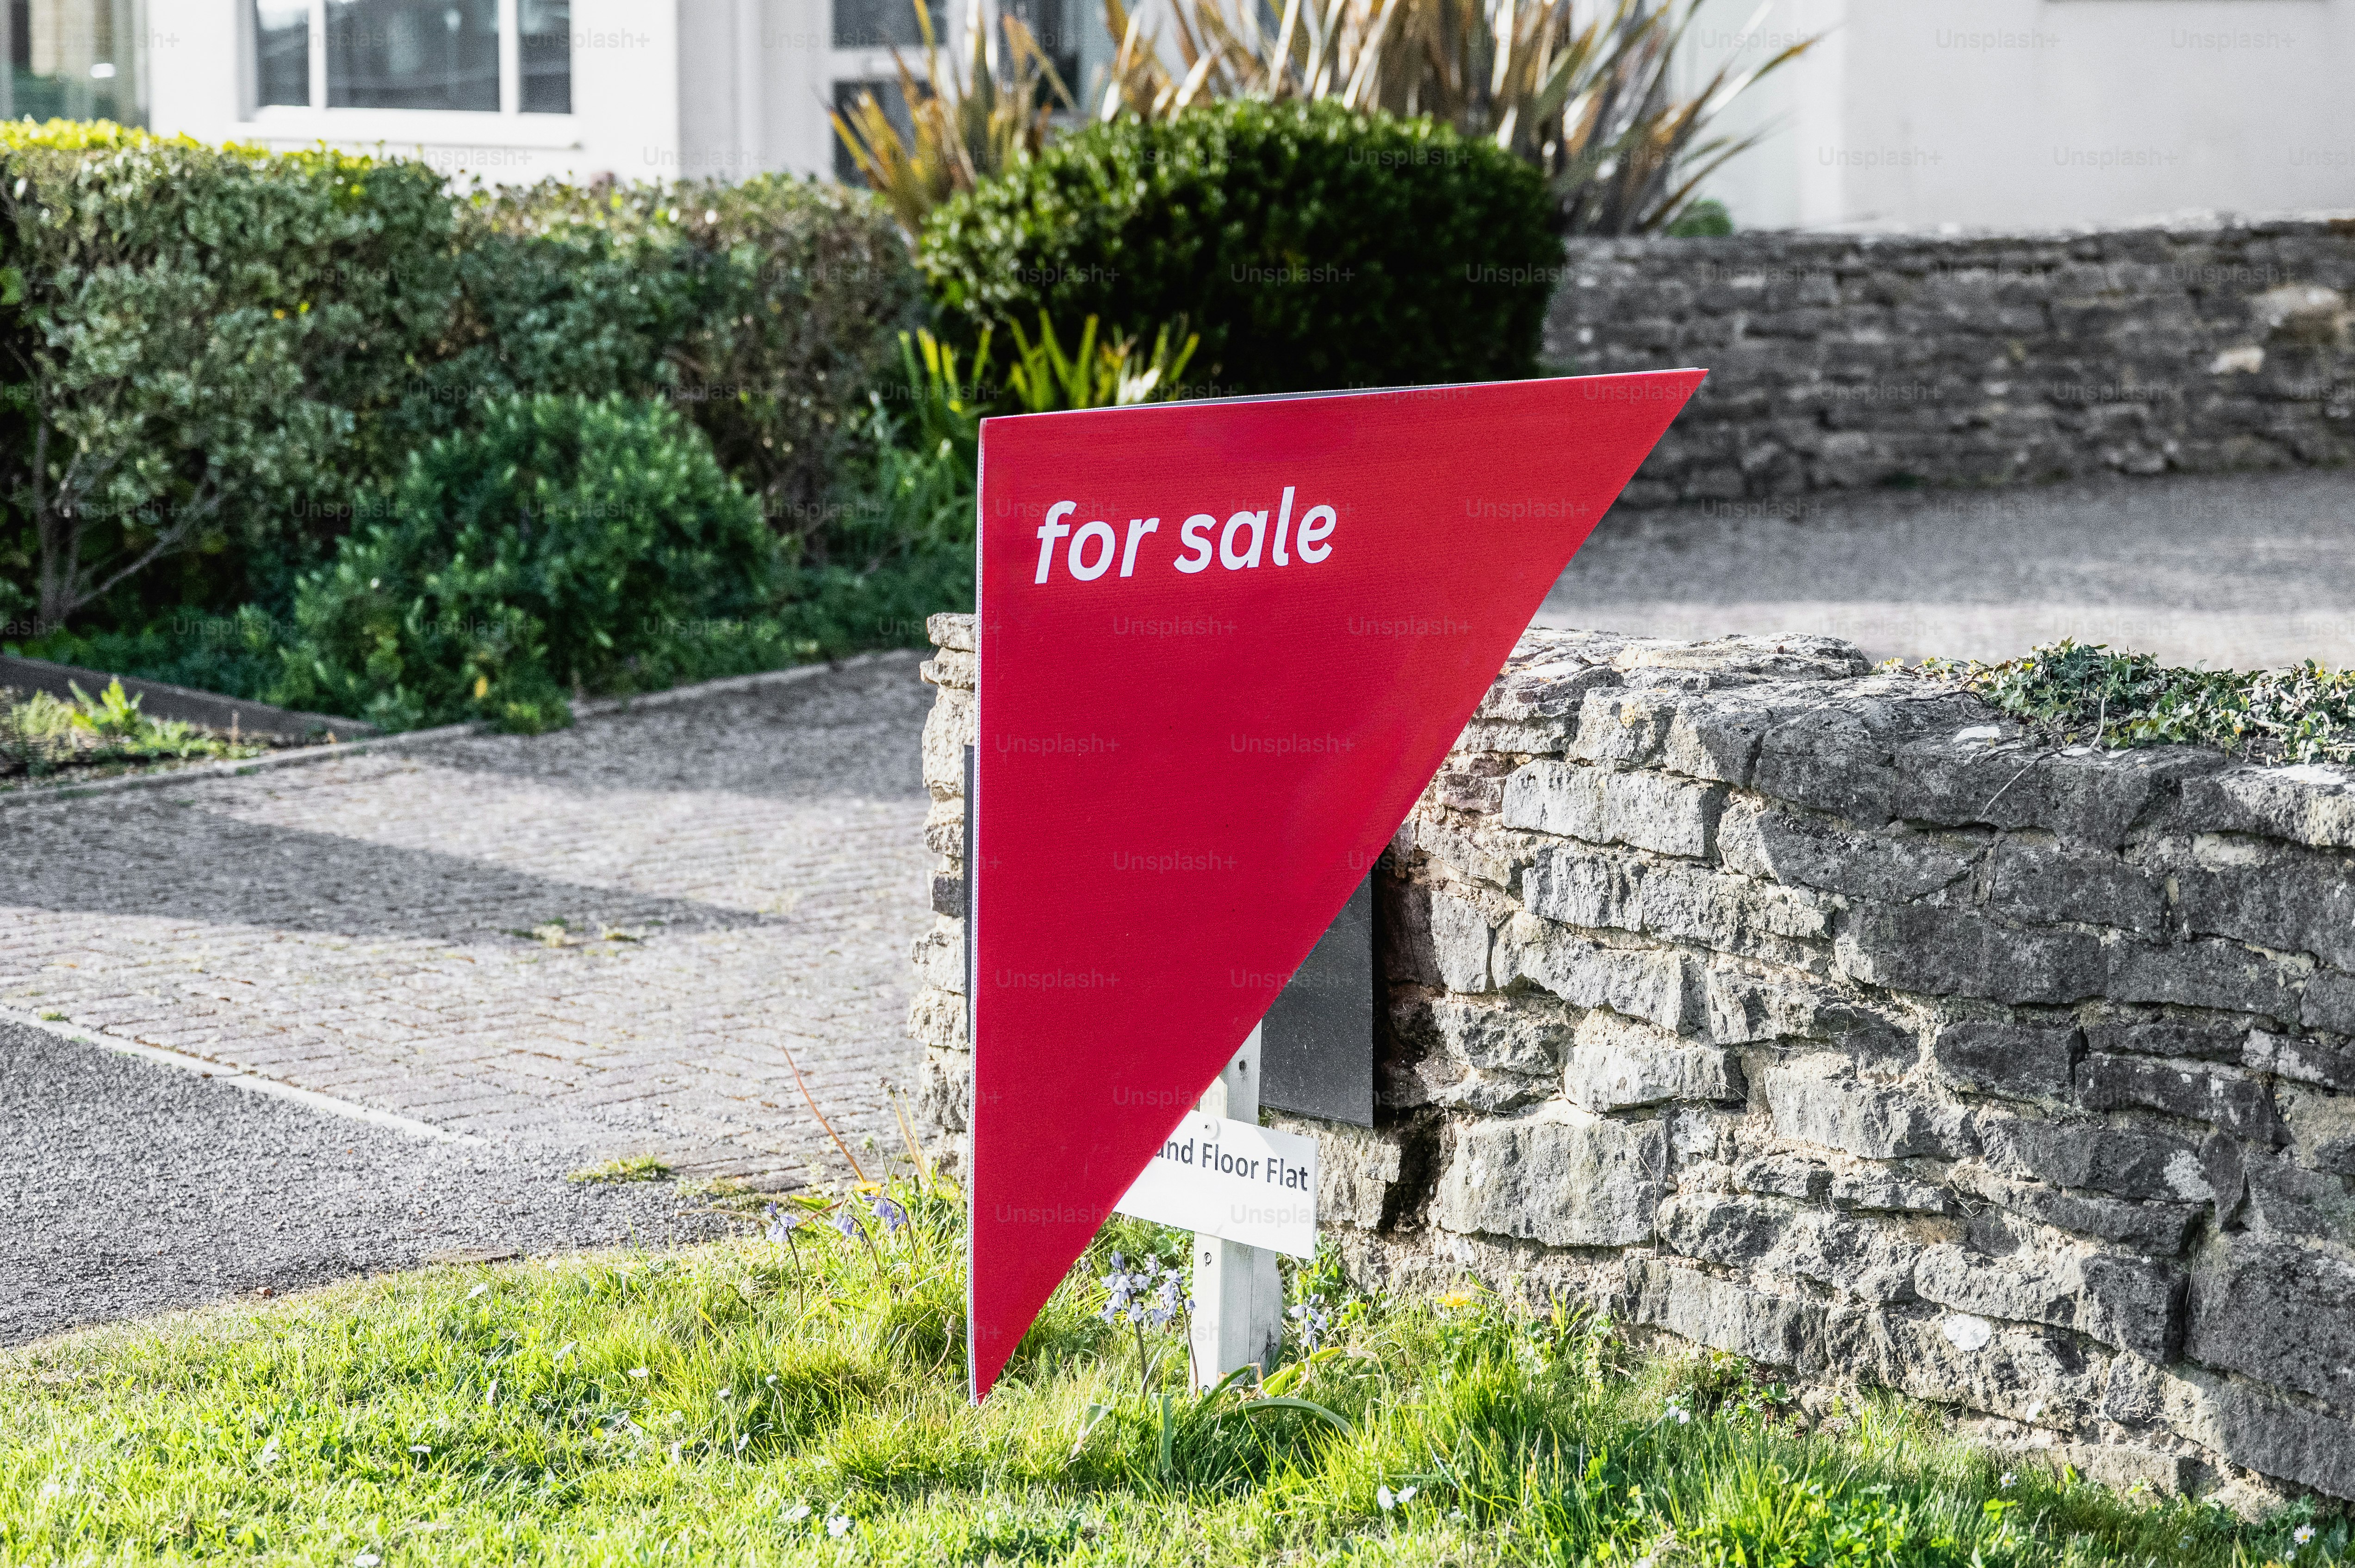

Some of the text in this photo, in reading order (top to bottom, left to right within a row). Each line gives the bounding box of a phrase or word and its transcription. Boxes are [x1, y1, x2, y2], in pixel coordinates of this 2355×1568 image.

[1034, 486, 1337, 585] for sale
[1202, 1143, 1259, 1179] Floor
[1267, 1157, 1308, 1192] Flat
